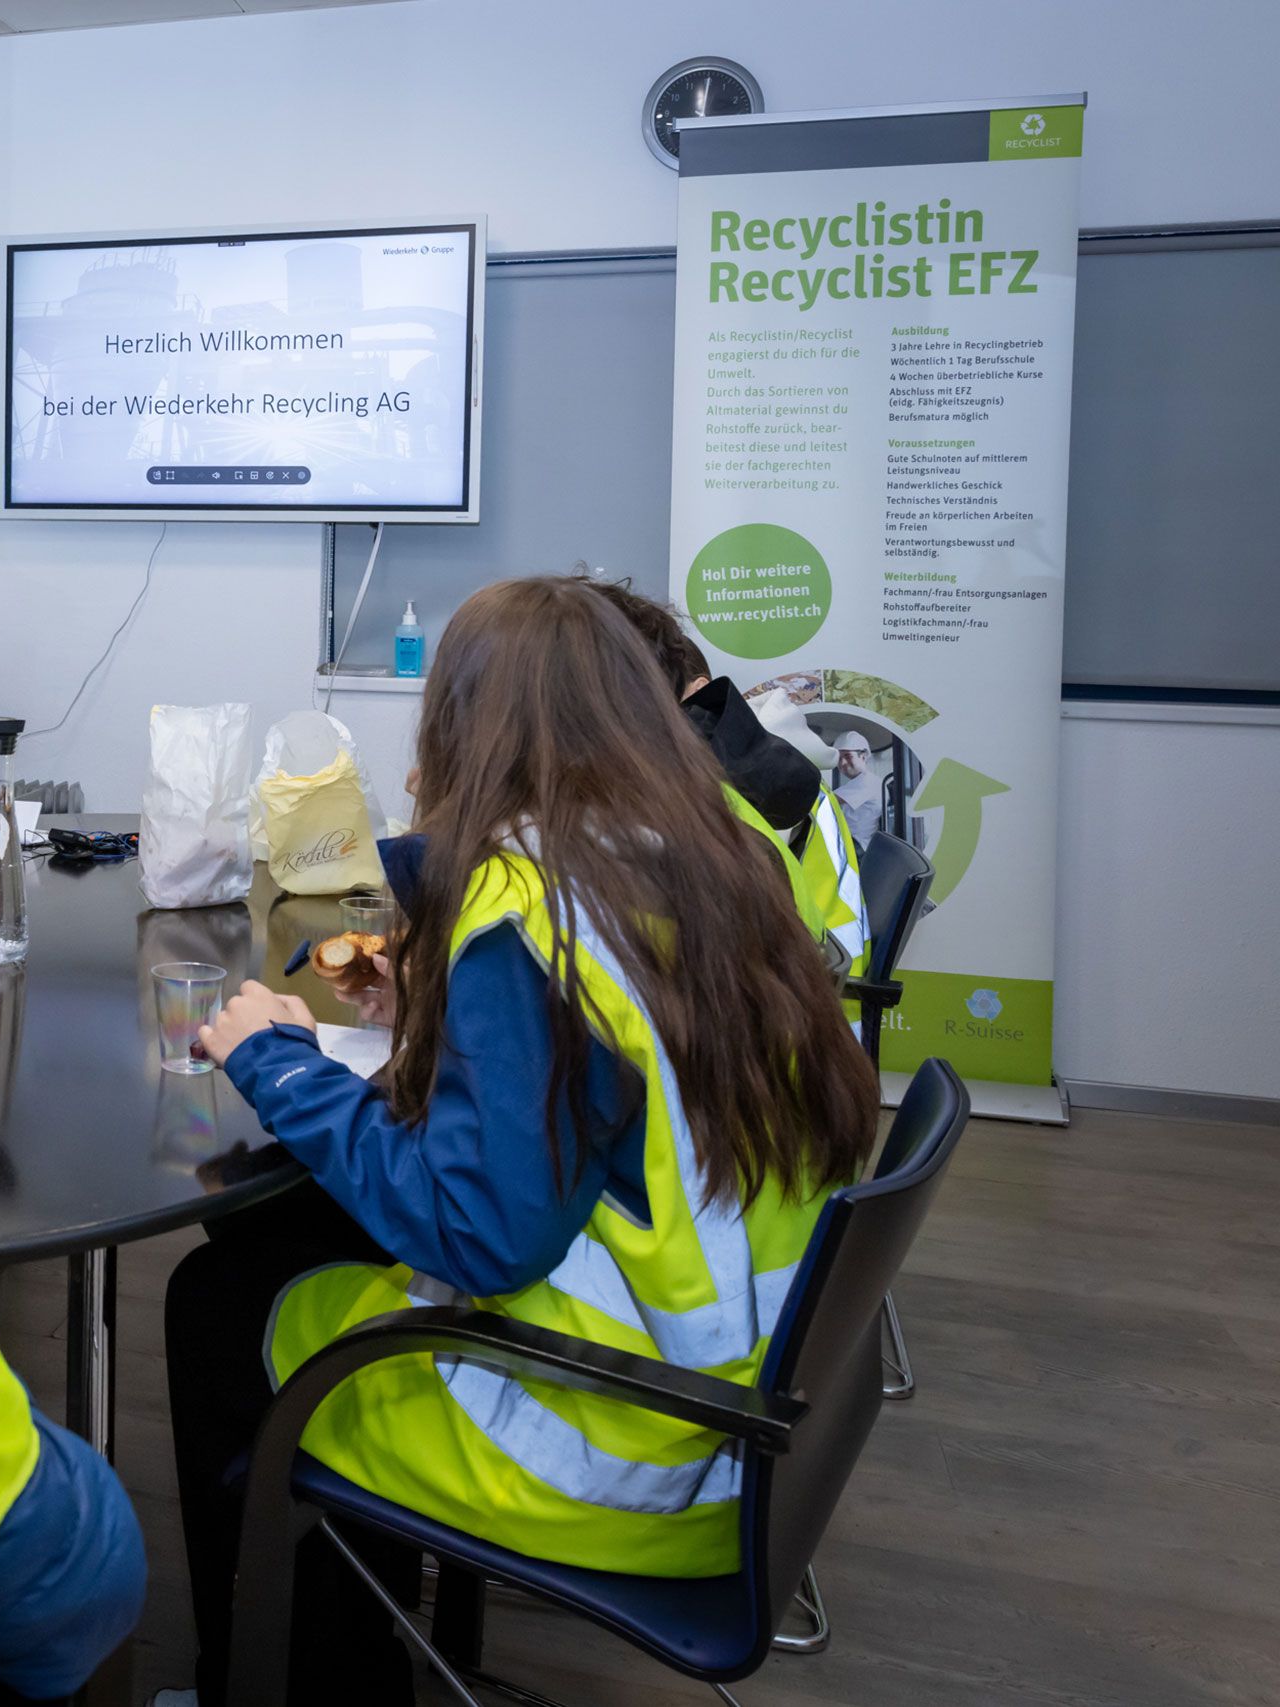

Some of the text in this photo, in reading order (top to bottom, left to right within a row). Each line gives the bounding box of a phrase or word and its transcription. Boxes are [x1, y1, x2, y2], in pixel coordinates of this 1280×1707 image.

[671, 93, 680, 102] 10
[1005, 137, 1062, 149] RECYCLIST
[710, 198, 984, 261] Recyclistin
[382, 246, 455, 256] Wiederkehr Gruppe
[709, 250, 1040, 312] Recyclist EFZ
[709, 329, 853, 343] Als Recyclistin/Recyclist
[892, 326, 949, 336] Ausbildung
[105, 330, 343, 355] Herzlich Willkommen
[891, 343, 897, 351] 3
[899, 342, 922, 351] Jahre
[925, 342, 950, 350] Lehre
[965, 340, 1043, 350] Recyclingbetrieb
[708, 347, 860, 362] engagierst du dich für die
[891, 356, 1035, 366] Wöchentlich 1 Tag Berufsschule
[708, 368, 755, 379] Umwelt.
[890, 371, 1043, 381] 4 Wochen überbetriebliche Kurse
[707, 386, 848, 398] Durch das Sortieren von
[890, 388, 934, 396] Abschluss
[955, 387, 972, 395] EFZ
[43, 391, 411, 418] bei der Wiederkehr Recycling AG
[889, 396, 1004, 408] (eidg. Fähigkeitszeugnis)
[706, 404, 848, 417] Altmaterial gewinnst du
[889, 412, 989, 422] Berufsmatura möglich
[706, 422, 842, 434] Rohstoffe zurück, bear-
[706, 441, 847, 452] beitest diese und leitest
[888, 439, 975, 449] Voraussetzungen
[888, 454, 1028, 463] Gute Schulnoten auf mittlerem
[705, 460, 831, 472] sie der fachgerechten
[887, 467, 961, 476] Leistungsniveau
[705, 478, 839, 491] Weiterverarbeitung zu.
[887, 482, 1003, 490] Handwerkliches Geschick
[887, 496, 998, 505] Technisches Verständnis
[886, 511, 916, 519] Freude
[933, 512, 991, 521] körperlichen
[993, 512, 1033, 520] Arbeiten
[886, 523, 928, 531] im Freien
[885, 538, 1015, 548] Verantwortungsbewusst und
[885, 549, 939, 558] selbständig.
[702, 564, 811, 581] Hol Dir weitere
[884, 572, 957, 583] Weiterbildung
[706, 585, 810, 602] Informationen
[884, 588, 1048, 599] Fachmann/-frau Entsorgungsanlagen
[883, 603, 971, 612] Rohstoffaufbereiter
[698, 604, 821, 623] www.recyclist.ch
[883, 618, 988, 628] Logistikfachmann/-frau
[882, 633, 960, 643] Umweltingenieur
[880, 1010, 912, 1031] elt.
[945, 1019, 1025, 1042] R-Suisse
